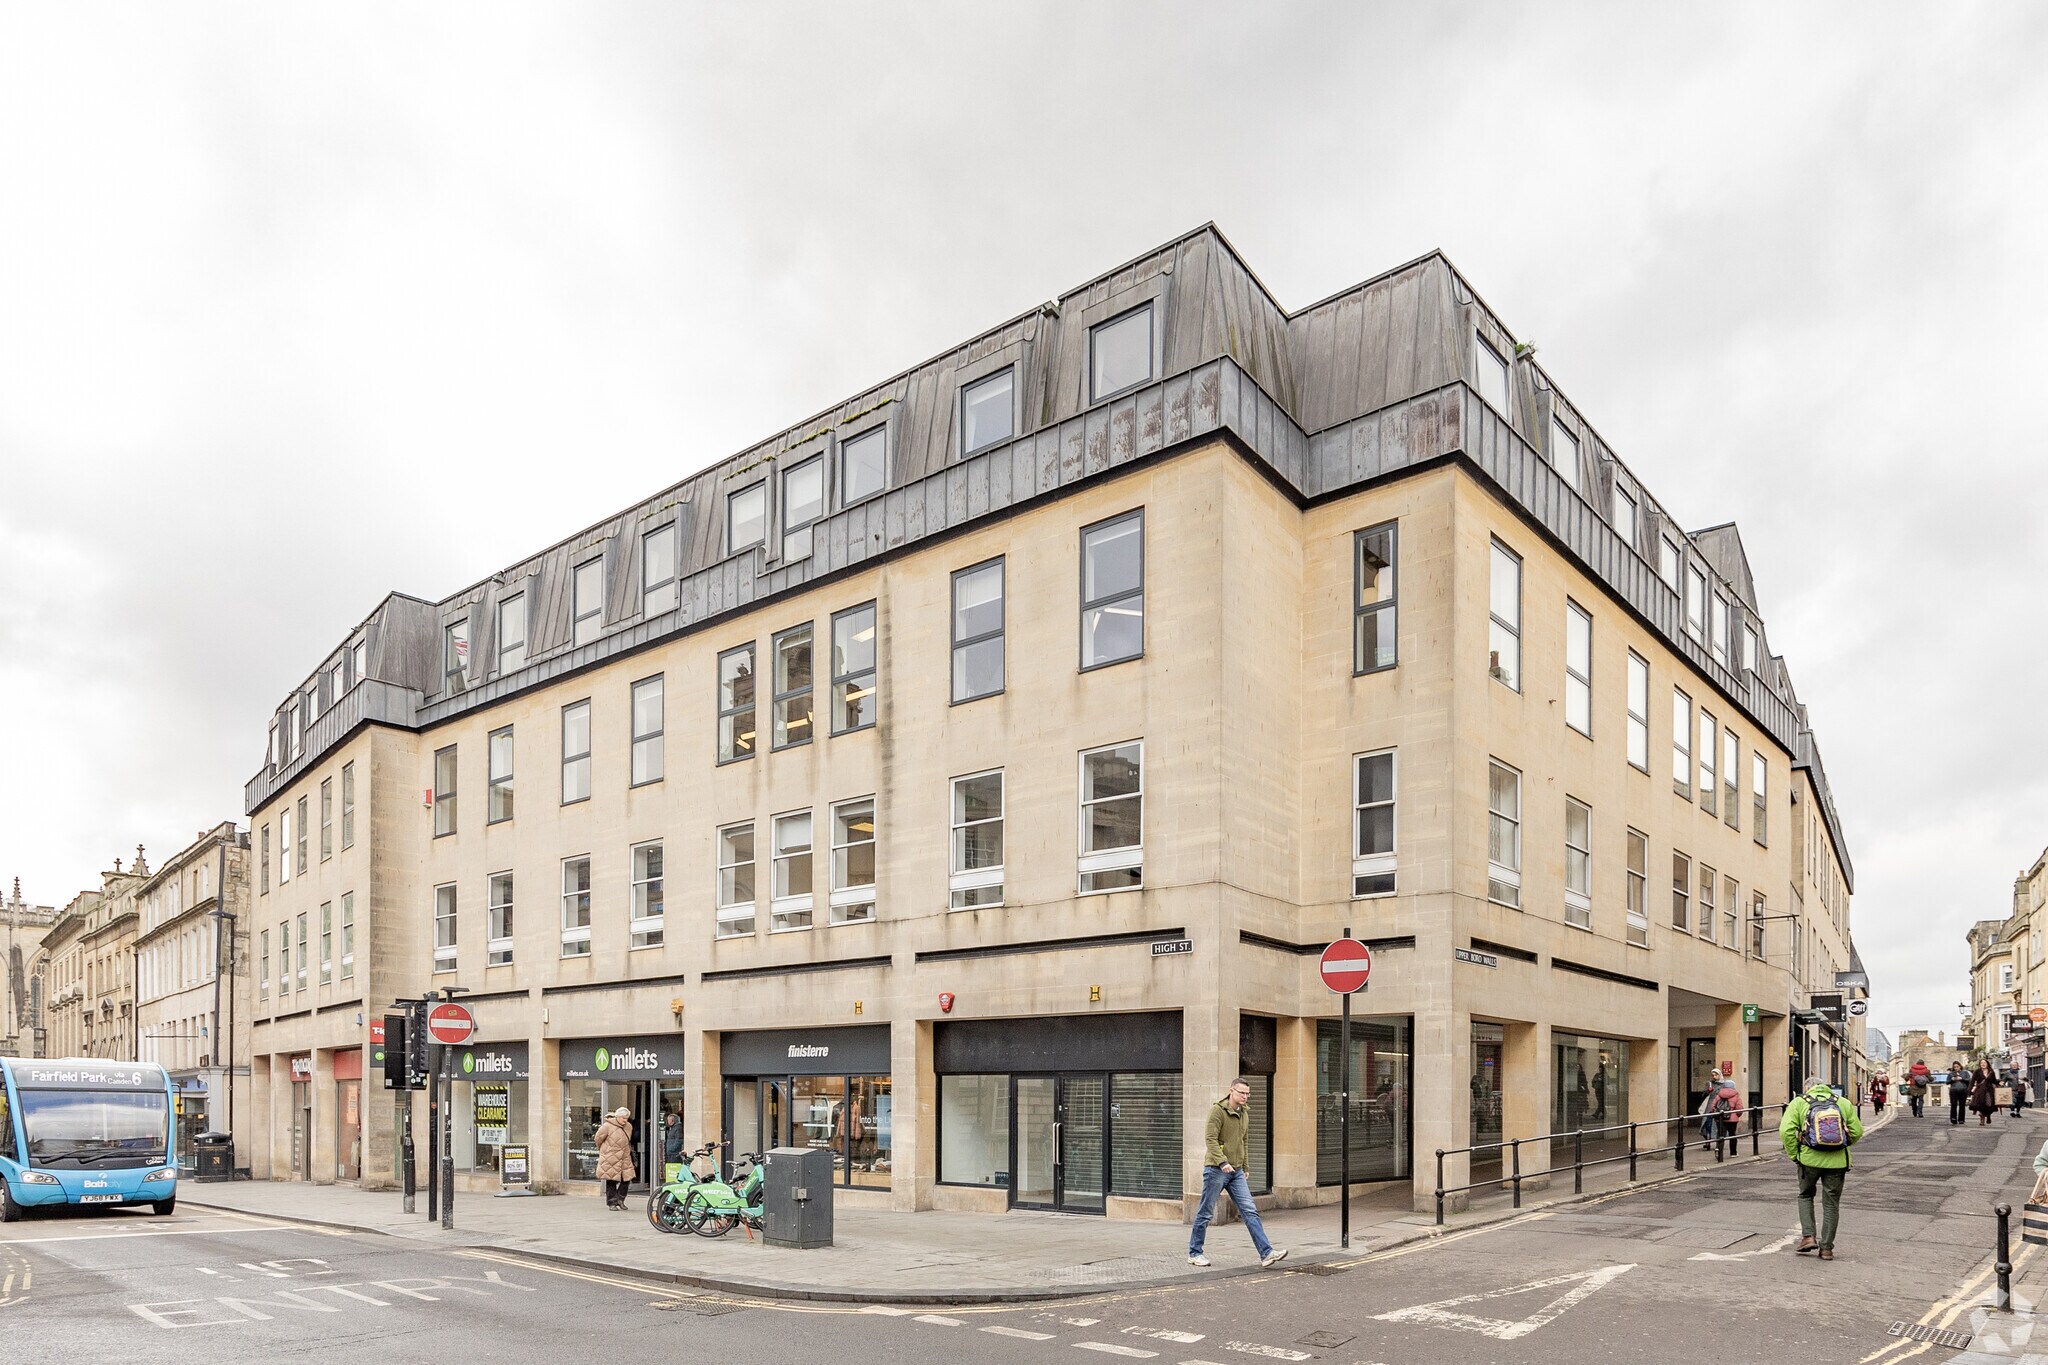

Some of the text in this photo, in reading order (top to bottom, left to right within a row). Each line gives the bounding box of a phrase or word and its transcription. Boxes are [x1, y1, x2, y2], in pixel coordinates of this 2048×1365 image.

[1154, 942, 1191, 953] HIGH ST.
[1456, 950, 1497, 967] UPPER BORO WALLS
[611, 1047, 658, 1070] millets
[788, 1045, 829, 1058] finisterre
[475, 1052, 512, 1072] millets
[31, 1070, 107, 1083] Fairfield Park
[131, 1072, 142, 1086] 6
[477, 1093, 507, 1107] WAREHOUSE
[477, 1107, 507, 1120] CLEARANCE
[126, 1270, 538, 1329] ENTRY
